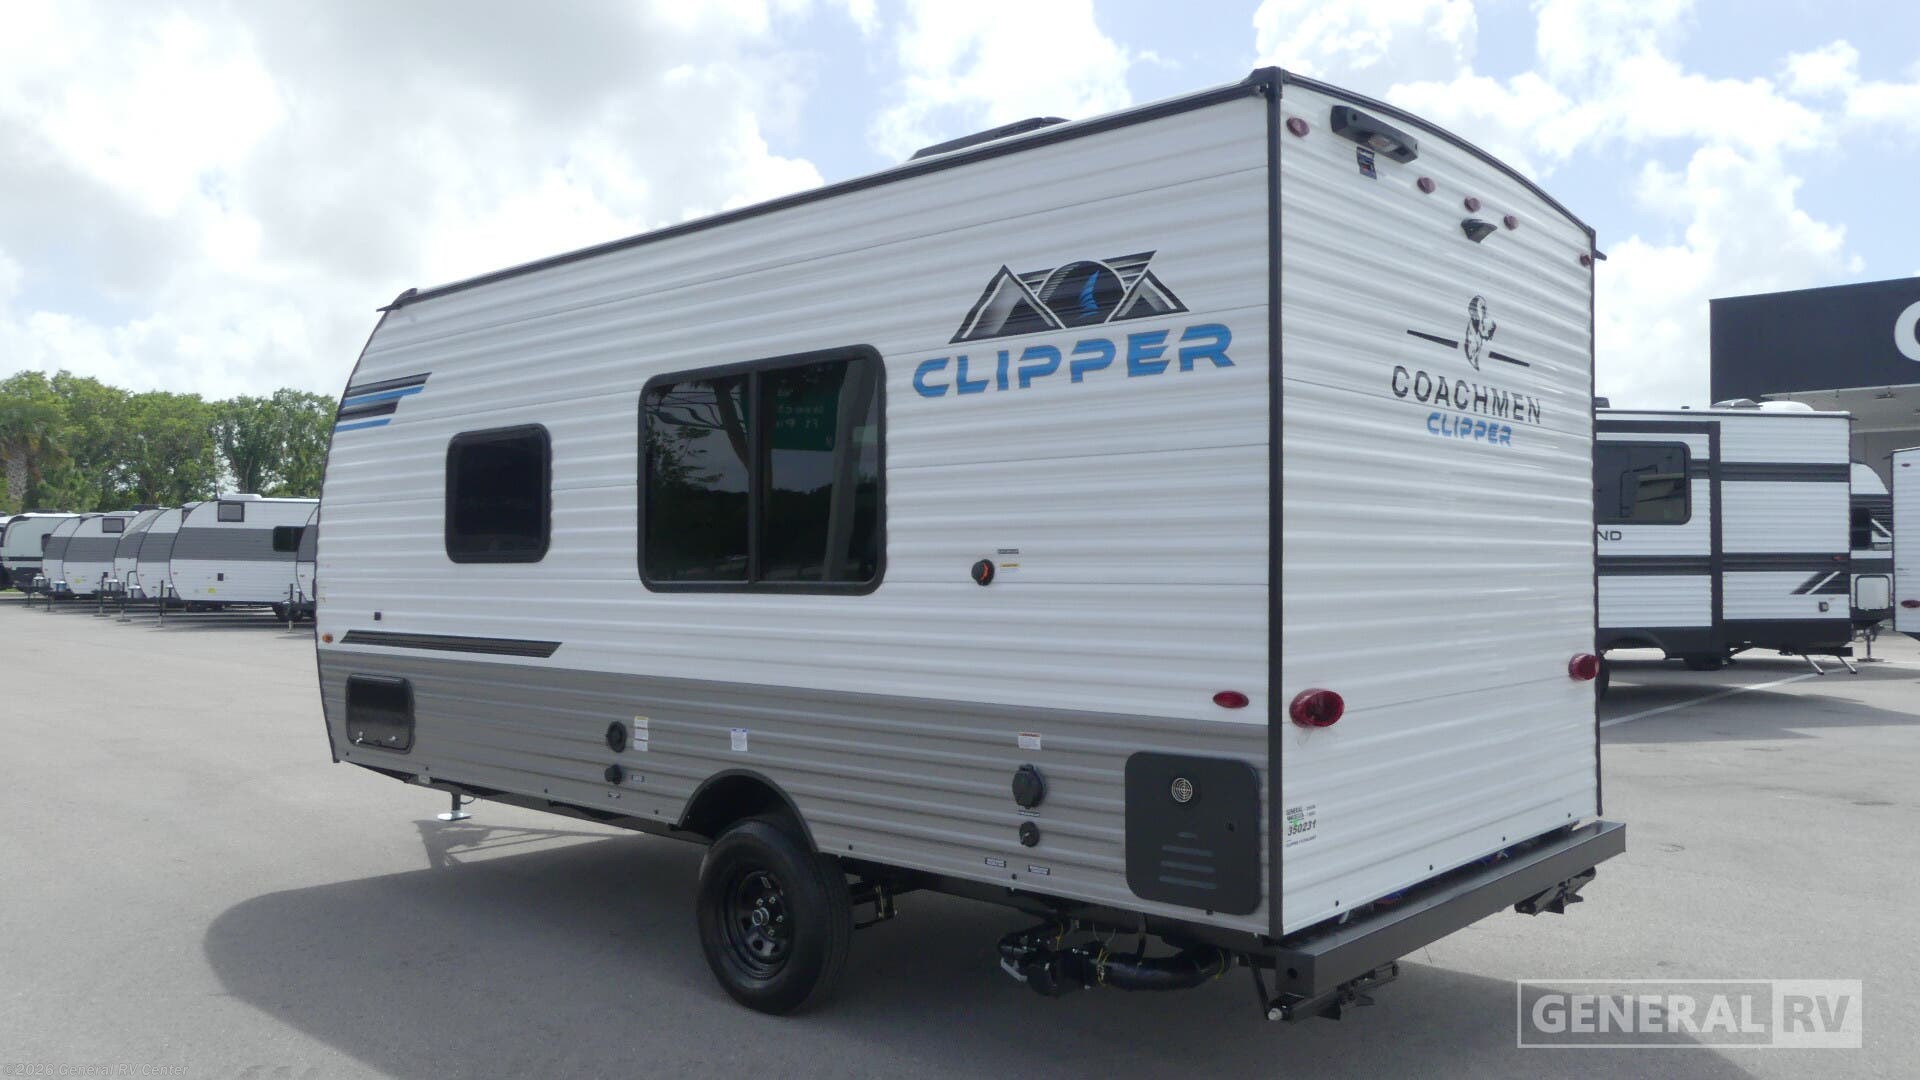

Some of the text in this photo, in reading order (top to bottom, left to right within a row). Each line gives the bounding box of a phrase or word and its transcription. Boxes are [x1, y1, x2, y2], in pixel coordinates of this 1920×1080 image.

[912, 322, 1236, 398] CLIPPER
[1391, 365, 1541, 424] COACHMEN
[1426, 411, 1512, 446] CLIPPER
[1287, 819, 1316, 836] 350231
